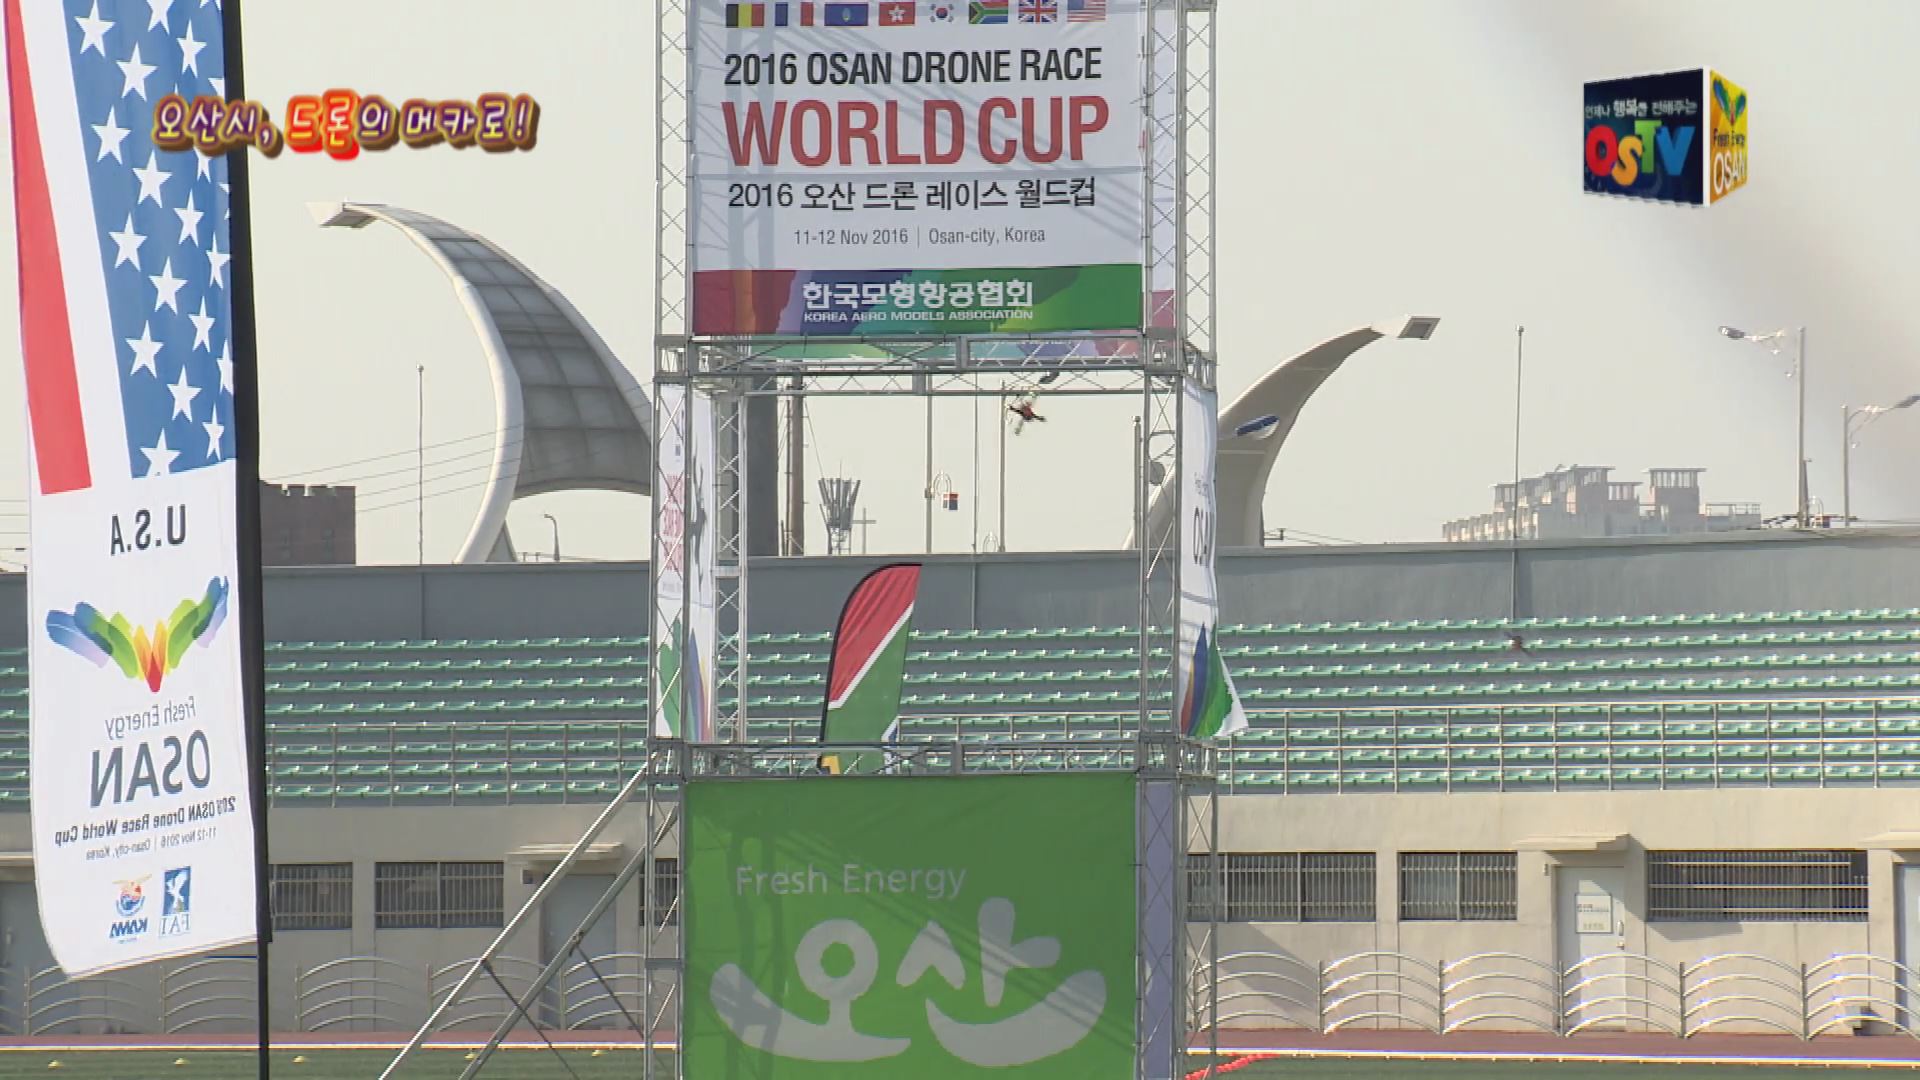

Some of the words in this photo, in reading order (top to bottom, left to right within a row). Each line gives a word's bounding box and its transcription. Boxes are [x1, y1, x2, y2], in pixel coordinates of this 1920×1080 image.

[724, 53, 798, 86] 2016
[807, 51, 893, 85] OSAN
[902, 49, 1011, 83] DRONE
[1019, 47, 1103, 81] RACE
[721, 99, 966, 167] WORLD
[977, 95, 1110, 165] CUP
[728, 183, 794, 207] 2016
[800, 182, 856, 211] 오산
[862, 181, 919, 211] 드론
[926, 180, 1009, 210] 레이스
[1015, 176, 1096, 209] 월드컵
[794, 229, 836, 246] 11-12
[840, 229, 869, 245] Nov
[872, 228, 909, 245] 2016
[929, 227, 1000, 247] Osan-city,
[1004, 226, 1046, 244] Korea
[802, 279, 1034, 310] 한국모형항공협회
[804, 312, 848, 322] KOREA
[852, 311, 887, 322] AERO
[890, 311, 945, 321] MODELS
[949, 309, 1033, 320] ASSOCIATION
[735, 864, 828, 897] Fresh
[842, 864, 967, 899] Energy
[709, 896, 1107, 1068] 오산
